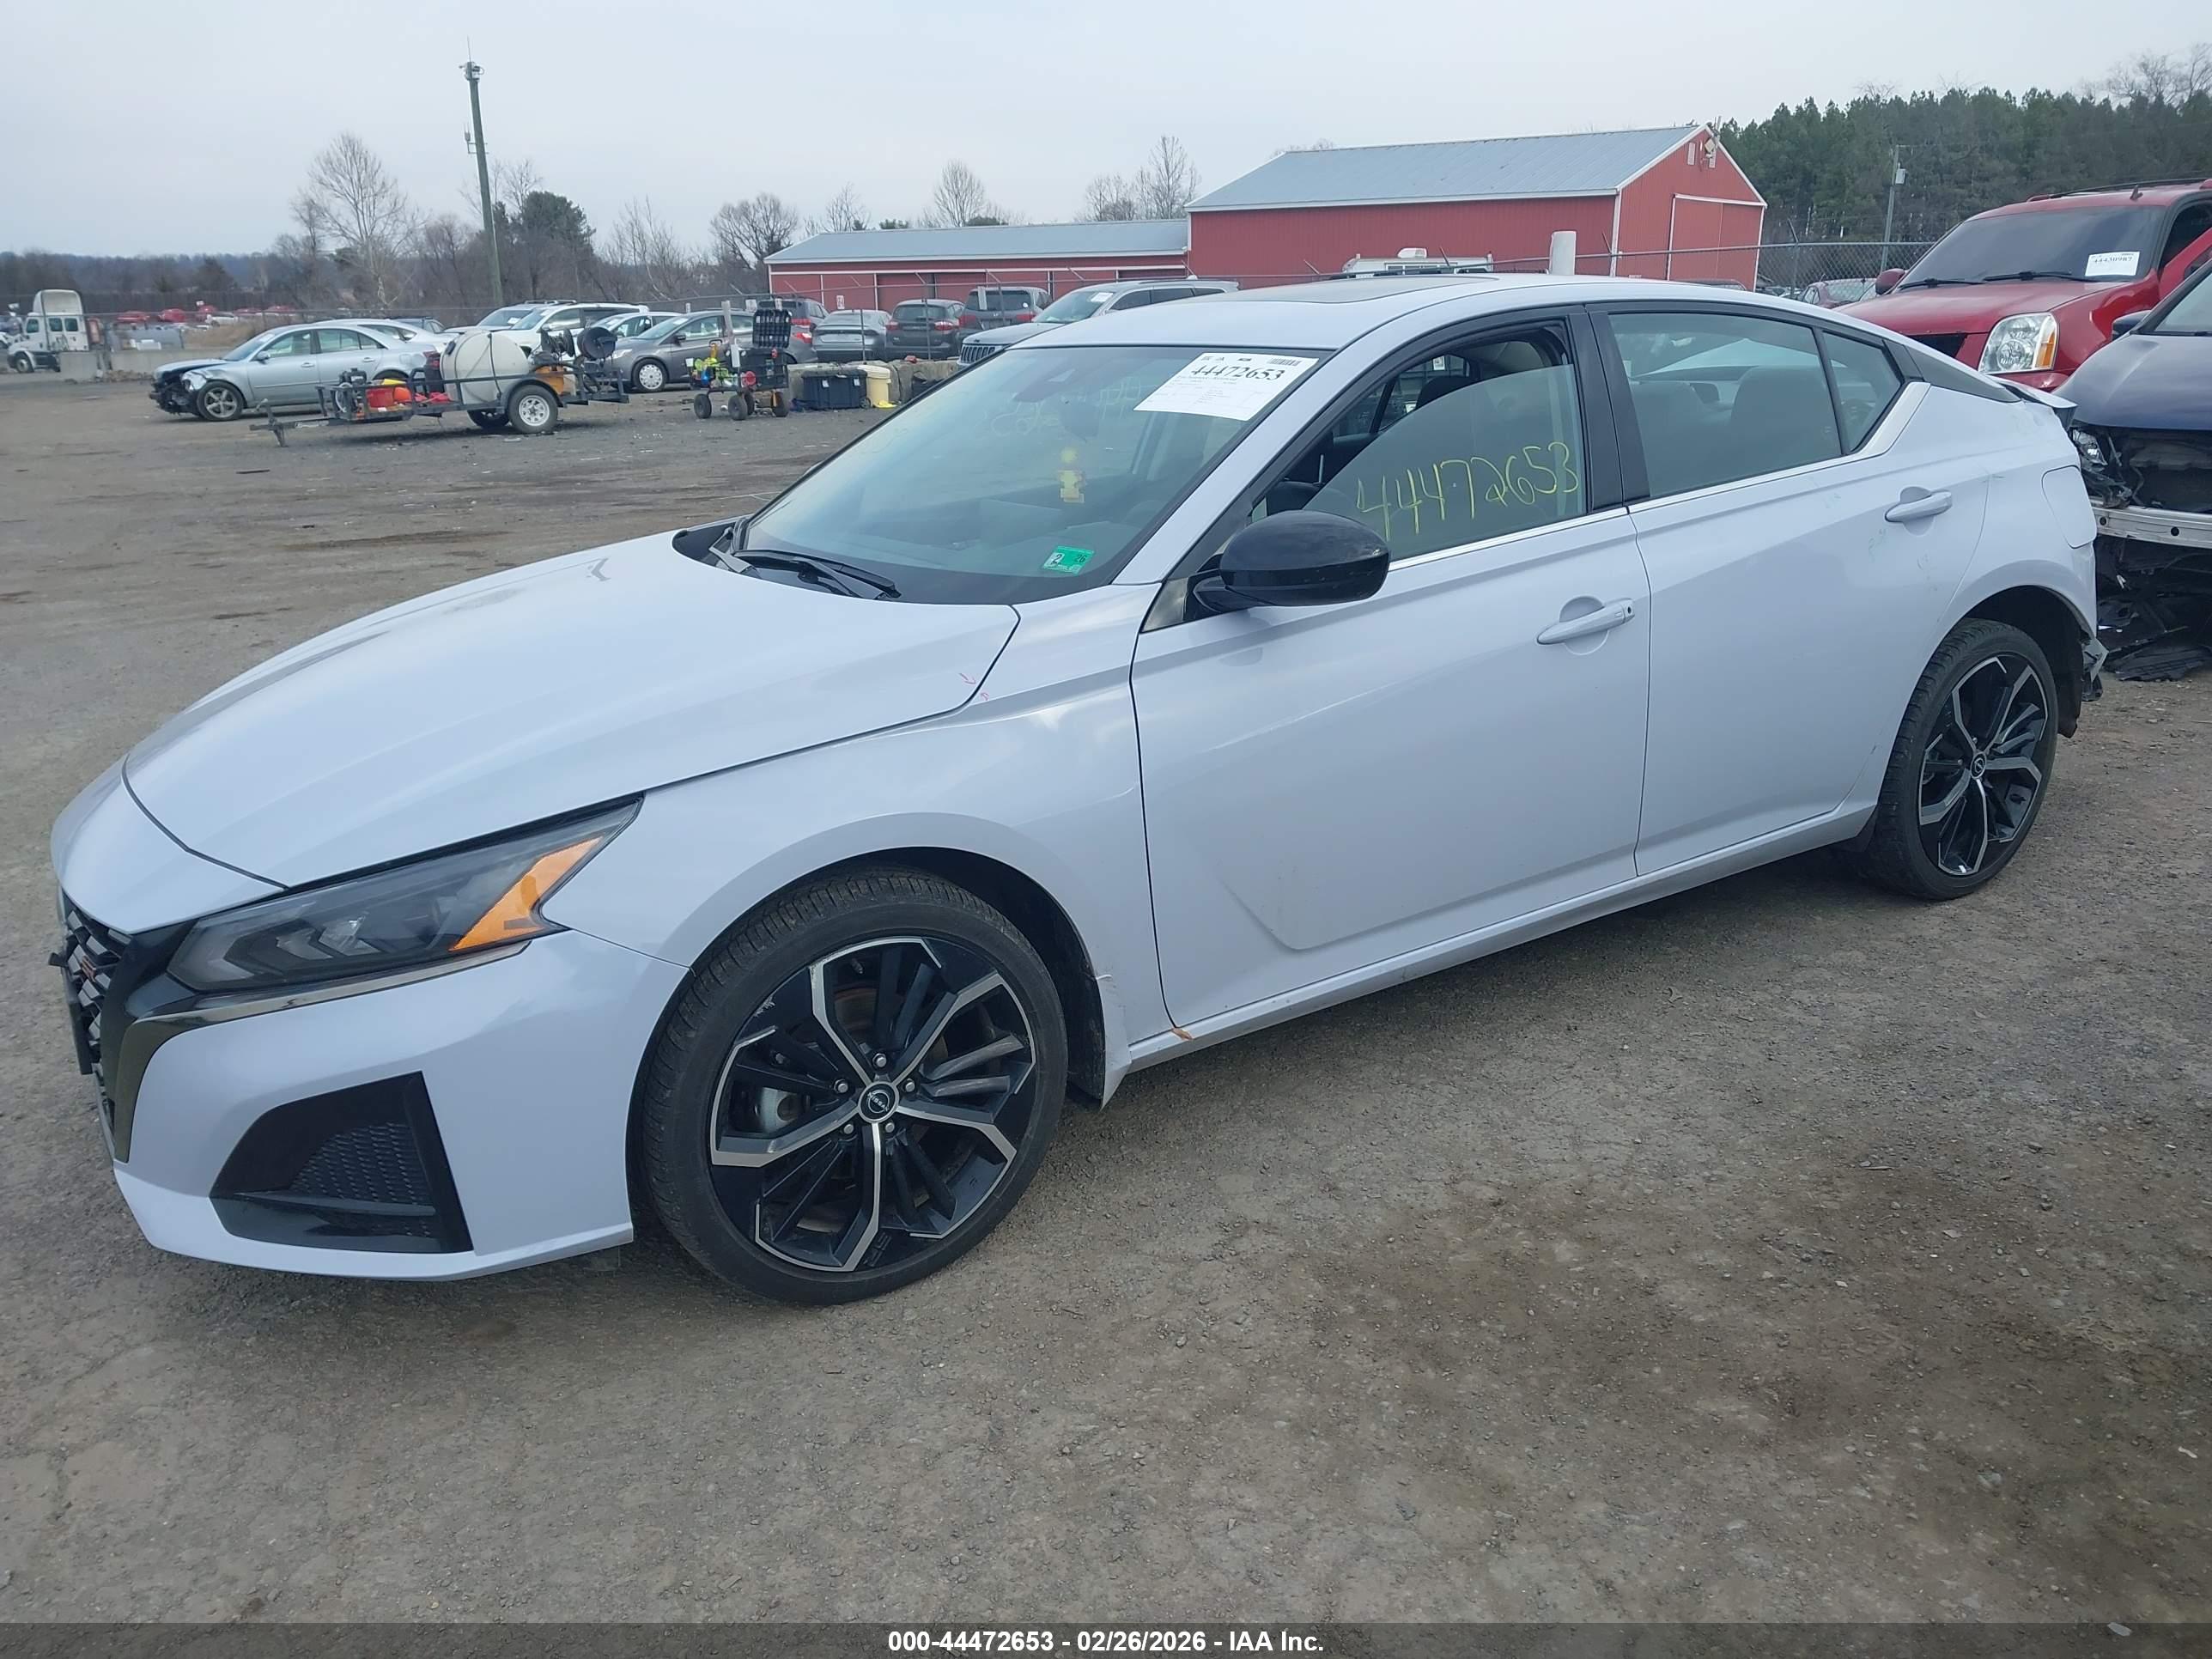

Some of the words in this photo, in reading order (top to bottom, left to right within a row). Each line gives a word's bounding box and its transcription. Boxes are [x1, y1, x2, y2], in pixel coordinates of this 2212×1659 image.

[1191, 365, 1285, 380] 44472653
[1356, 441, 1579, 541] 44472653
[1051, 553, 1062, 565] 2
